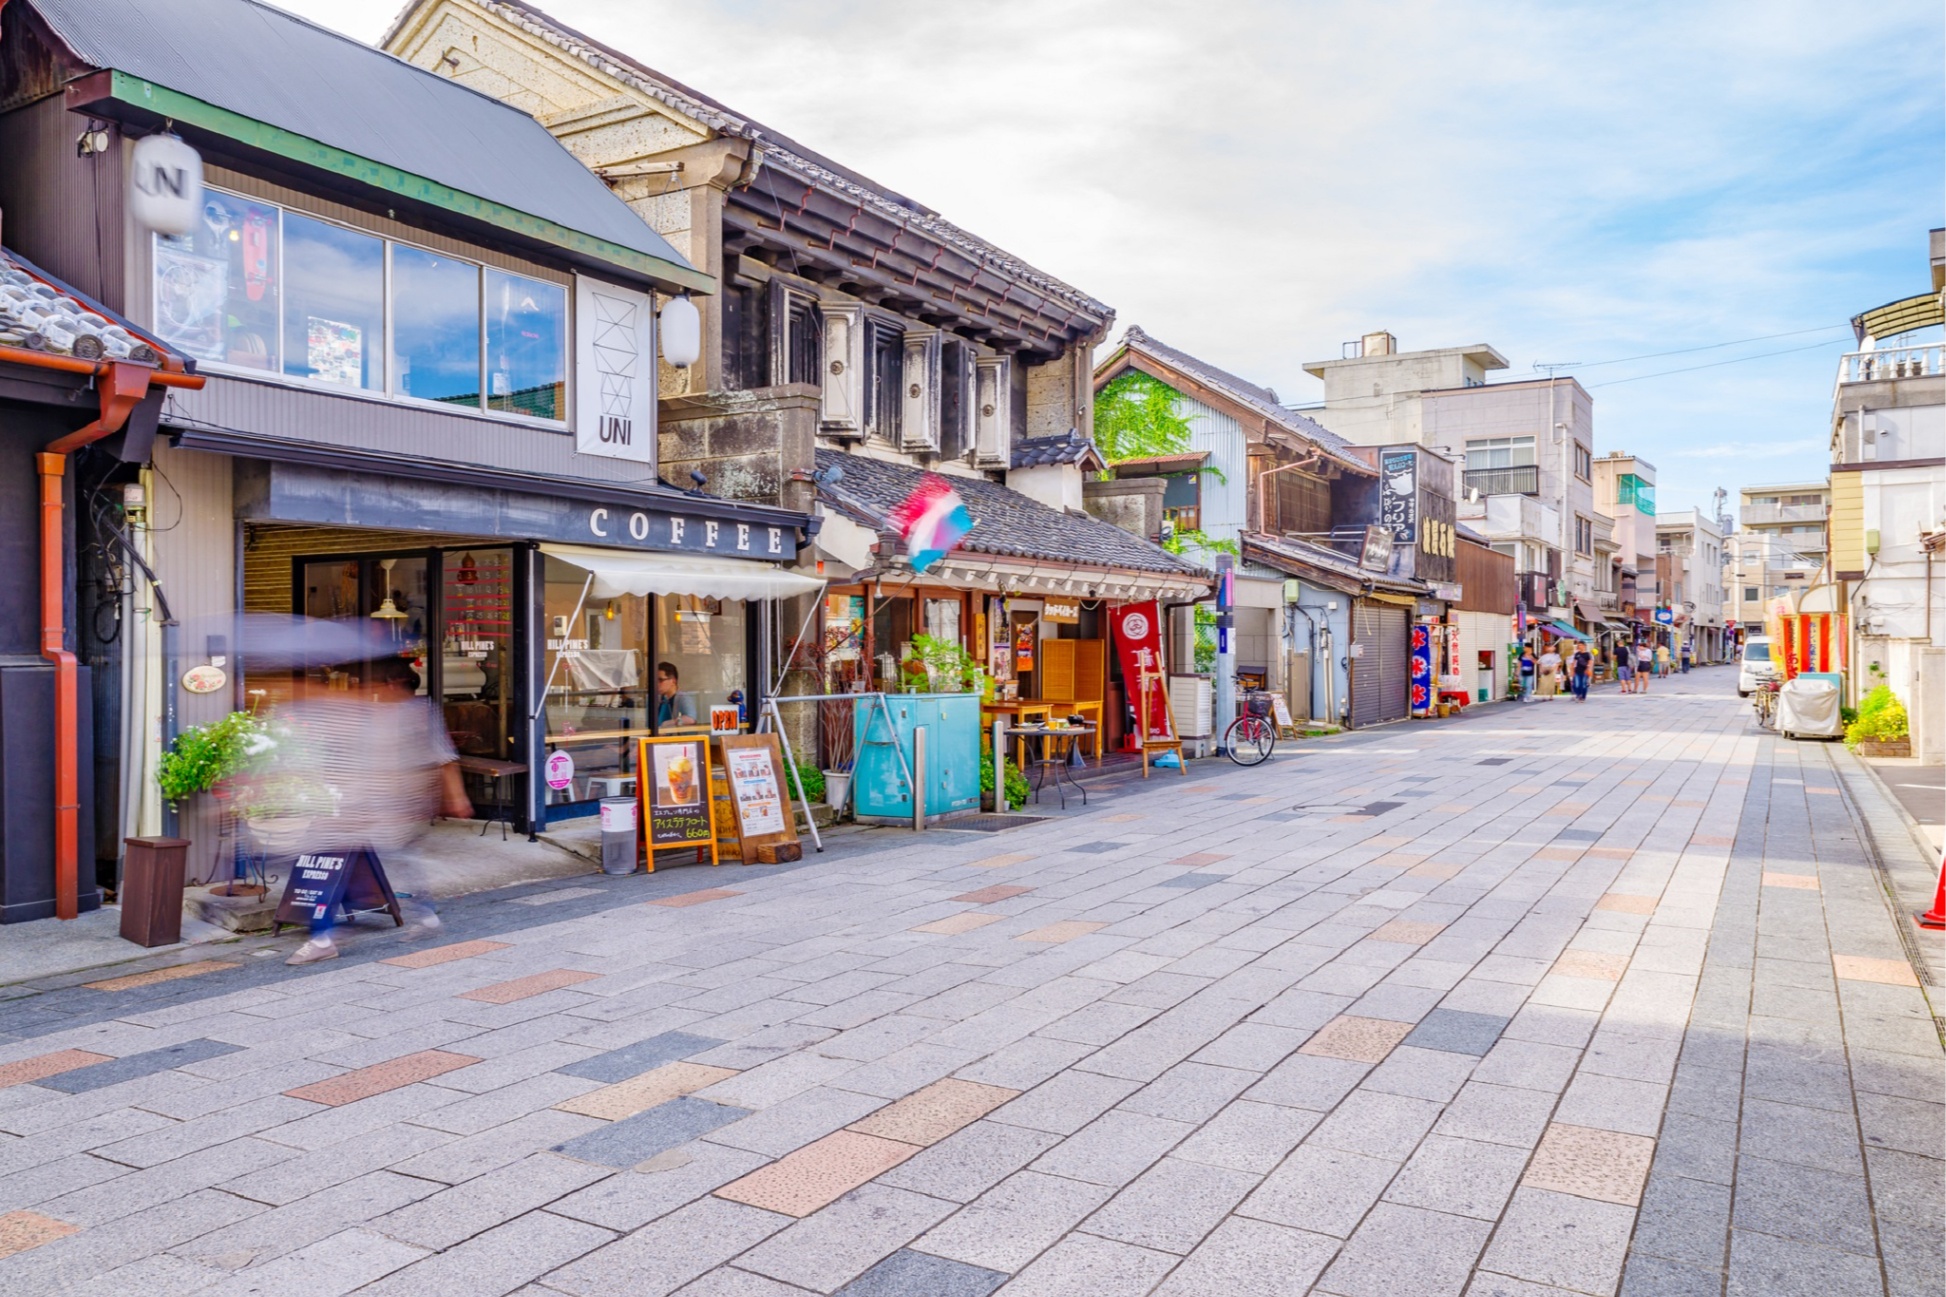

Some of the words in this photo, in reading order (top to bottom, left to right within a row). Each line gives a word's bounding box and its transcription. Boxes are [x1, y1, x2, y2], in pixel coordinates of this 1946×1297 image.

[600, 415, 631, 446] UNI
[589, 507, 782, 554] COFFEE
[711, 710, 738, 731] OPEN
